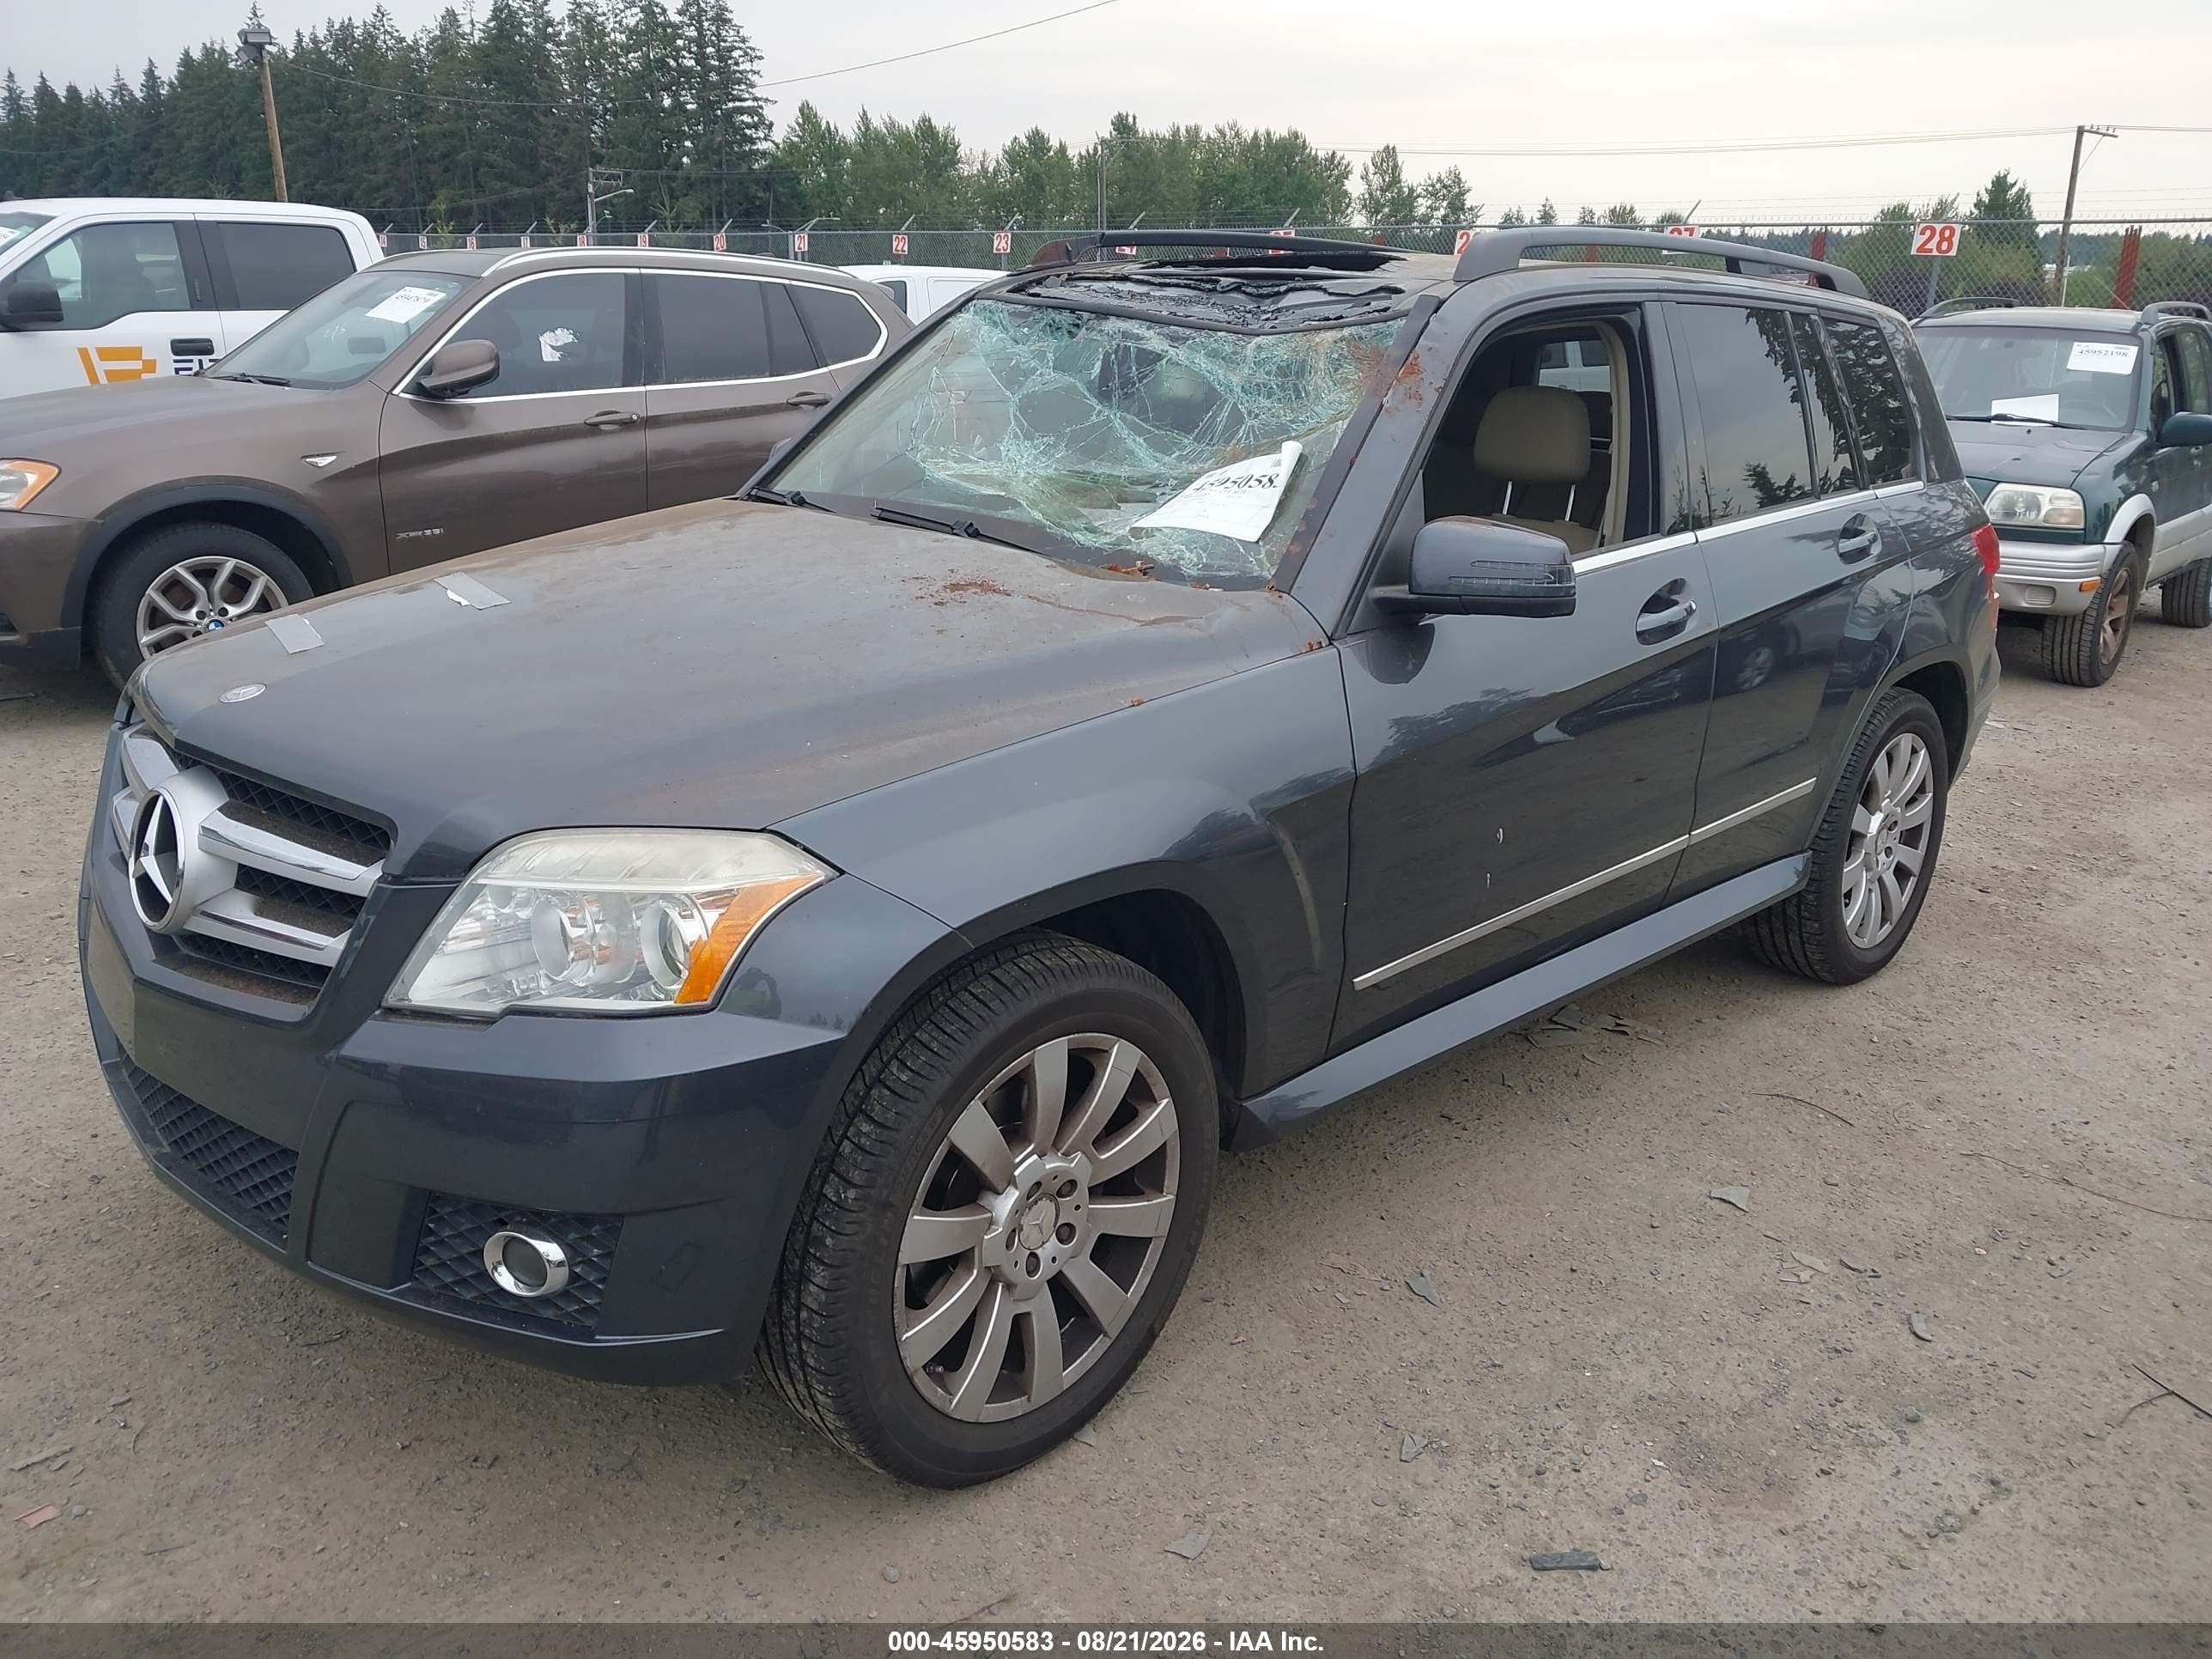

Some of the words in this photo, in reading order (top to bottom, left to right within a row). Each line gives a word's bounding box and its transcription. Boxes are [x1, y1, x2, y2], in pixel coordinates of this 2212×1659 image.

[640, 234, 647, 247] 19
[714, 234, 726, 250] 20
[797, 235, 806, 250] 21
[894, 236, 907, 252] 22
[994, 234, 1009, 252] 23
[1916, 225, 1956, 254] 28
[2078, 349, 2128, 357] 45952198
[1193, 472, 1279, 491] 4595058
